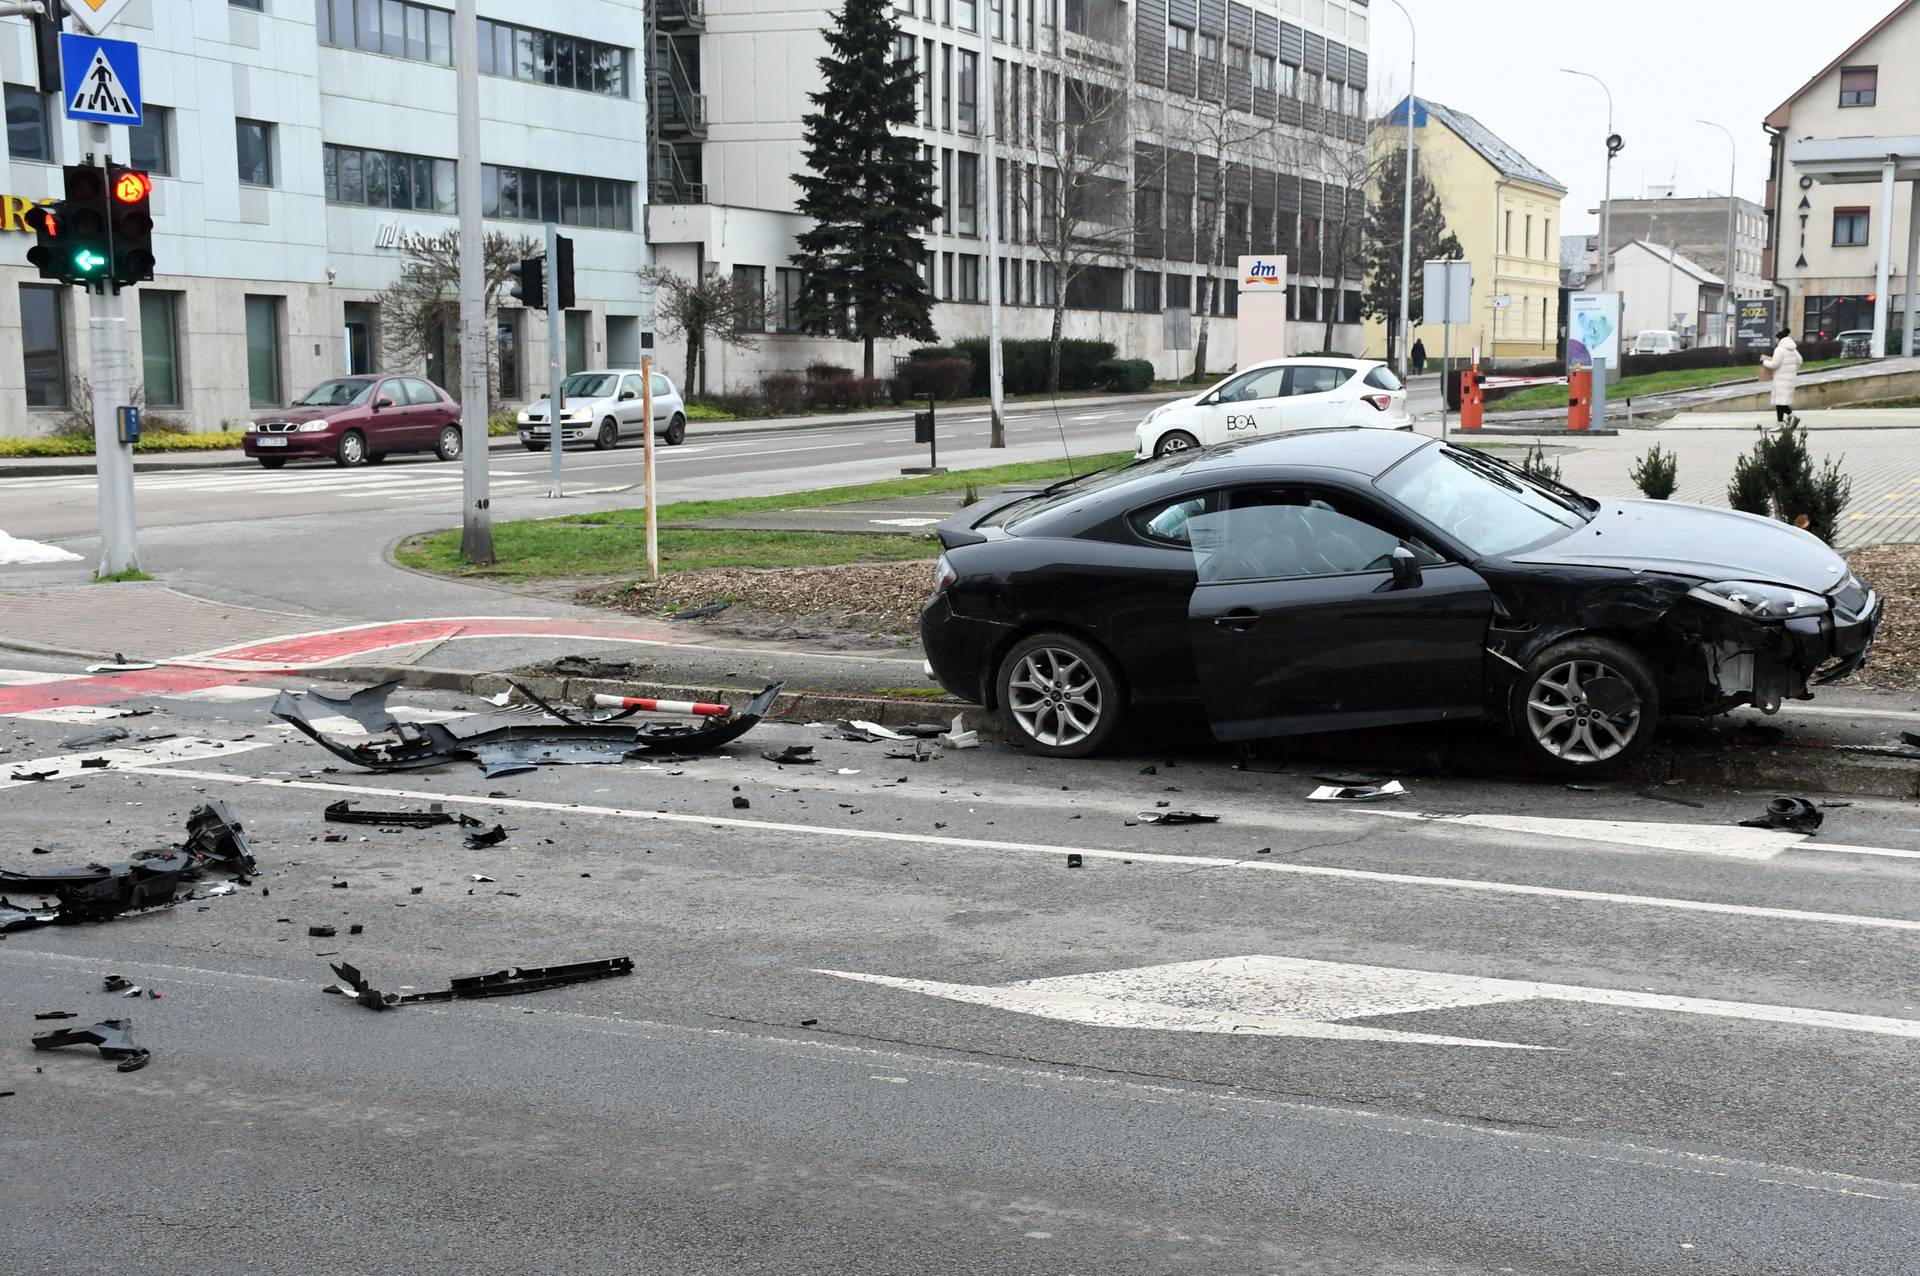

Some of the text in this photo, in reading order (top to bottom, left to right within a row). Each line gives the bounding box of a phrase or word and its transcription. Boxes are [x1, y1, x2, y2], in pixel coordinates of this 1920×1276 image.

[1795, 174, 1813, 268] OATIA
[1251, 260, 1276, 276] dm
[1227, 415, 1257, 430] BOA
[475, 499, 489, 510] 40
